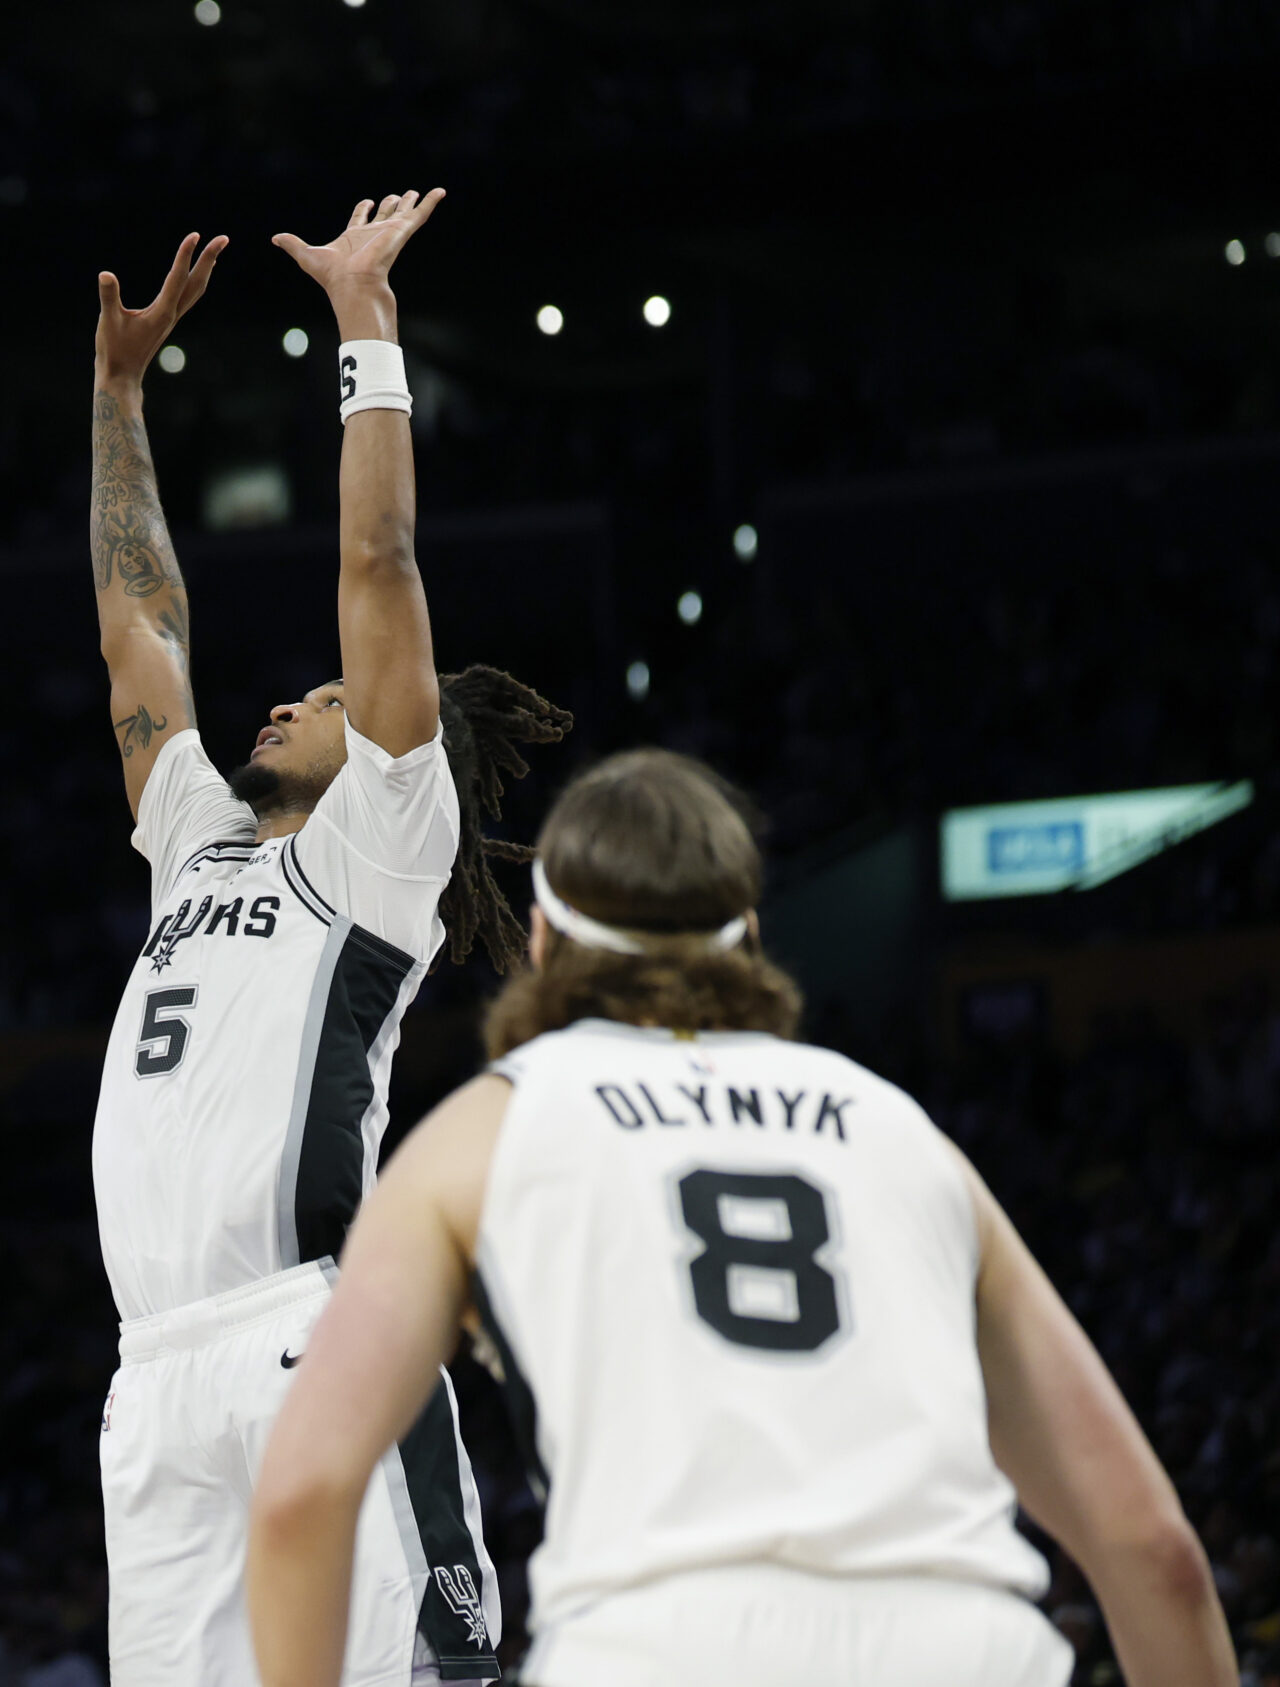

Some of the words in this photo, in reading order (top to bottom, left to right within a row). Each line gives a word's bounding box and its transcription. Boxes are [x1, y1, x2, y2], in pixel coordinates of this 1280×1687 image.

[134, 983, 200, 1080] 5
[593, 1079, 857, 1144] OLYNYK
[668, 1160, 850, 1362] 8
